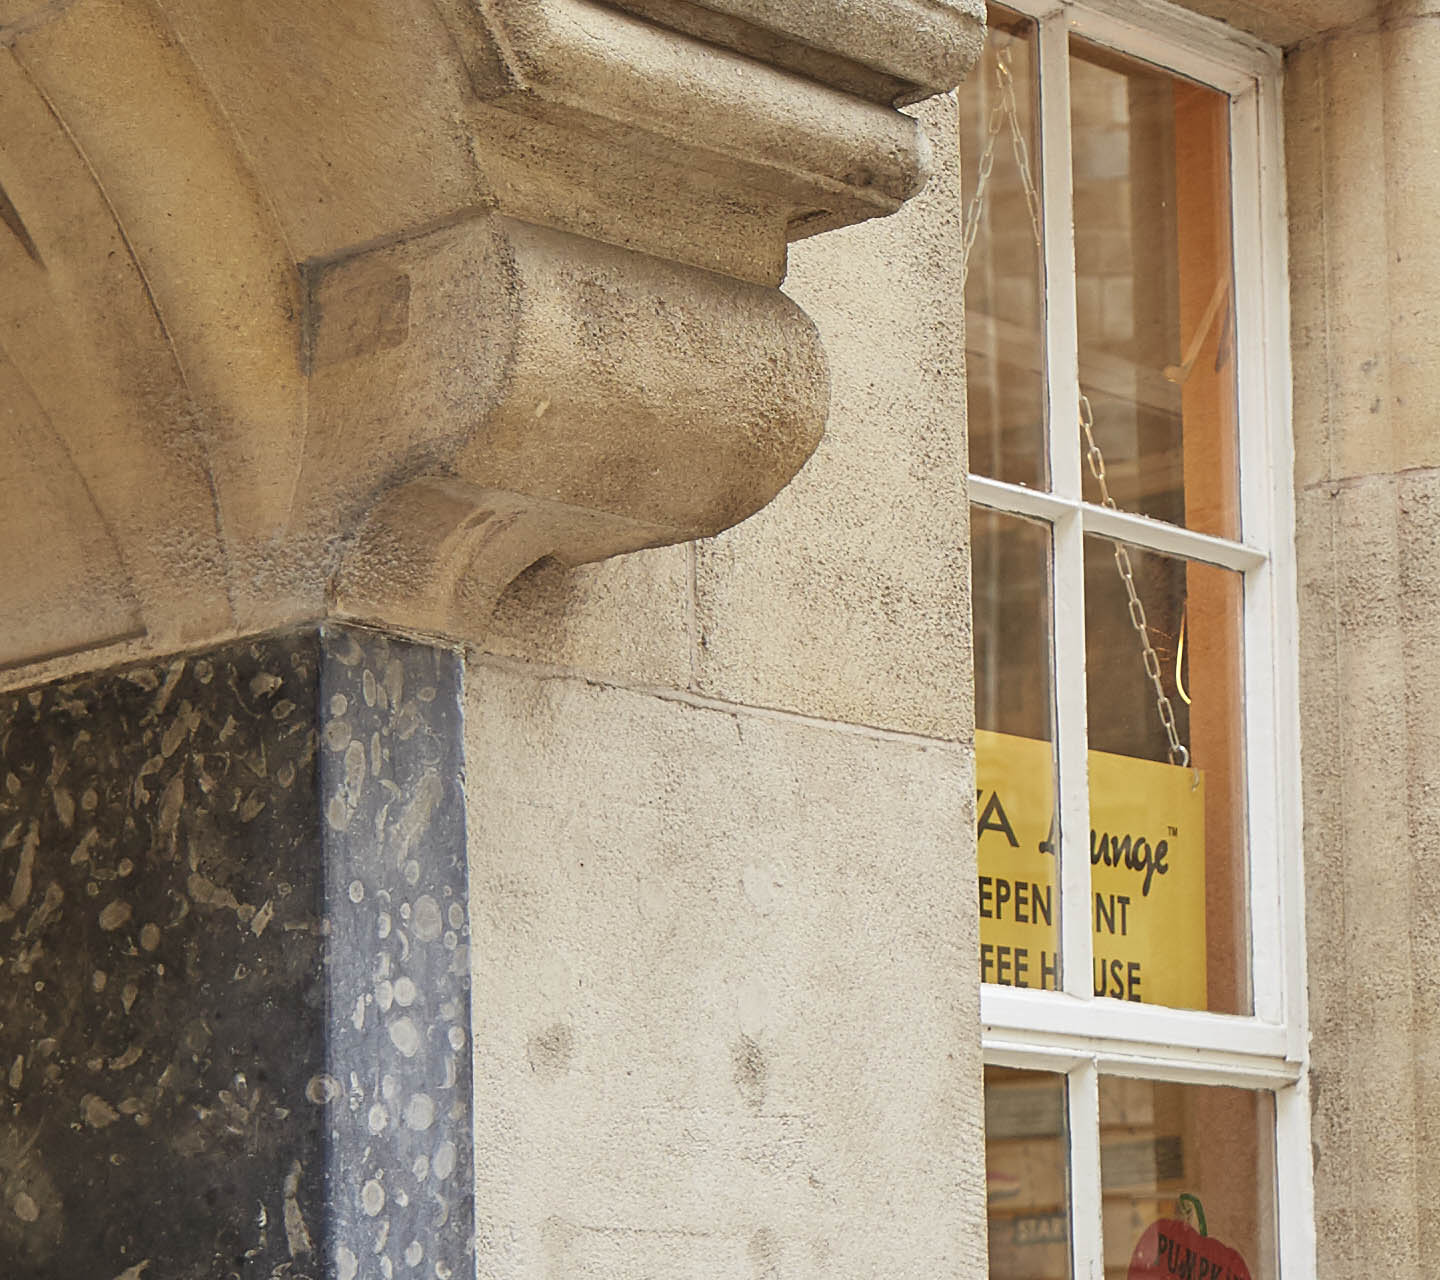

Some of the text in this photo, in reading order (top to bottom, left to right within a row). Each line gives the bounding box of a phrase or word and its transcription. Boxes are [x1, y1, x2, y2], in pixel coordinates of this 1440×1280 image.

[977, 789, 1020, 848] A
[979, 876, 1130, 936] EPENNT
[1041, 951, 1142, 1003] HUSE
